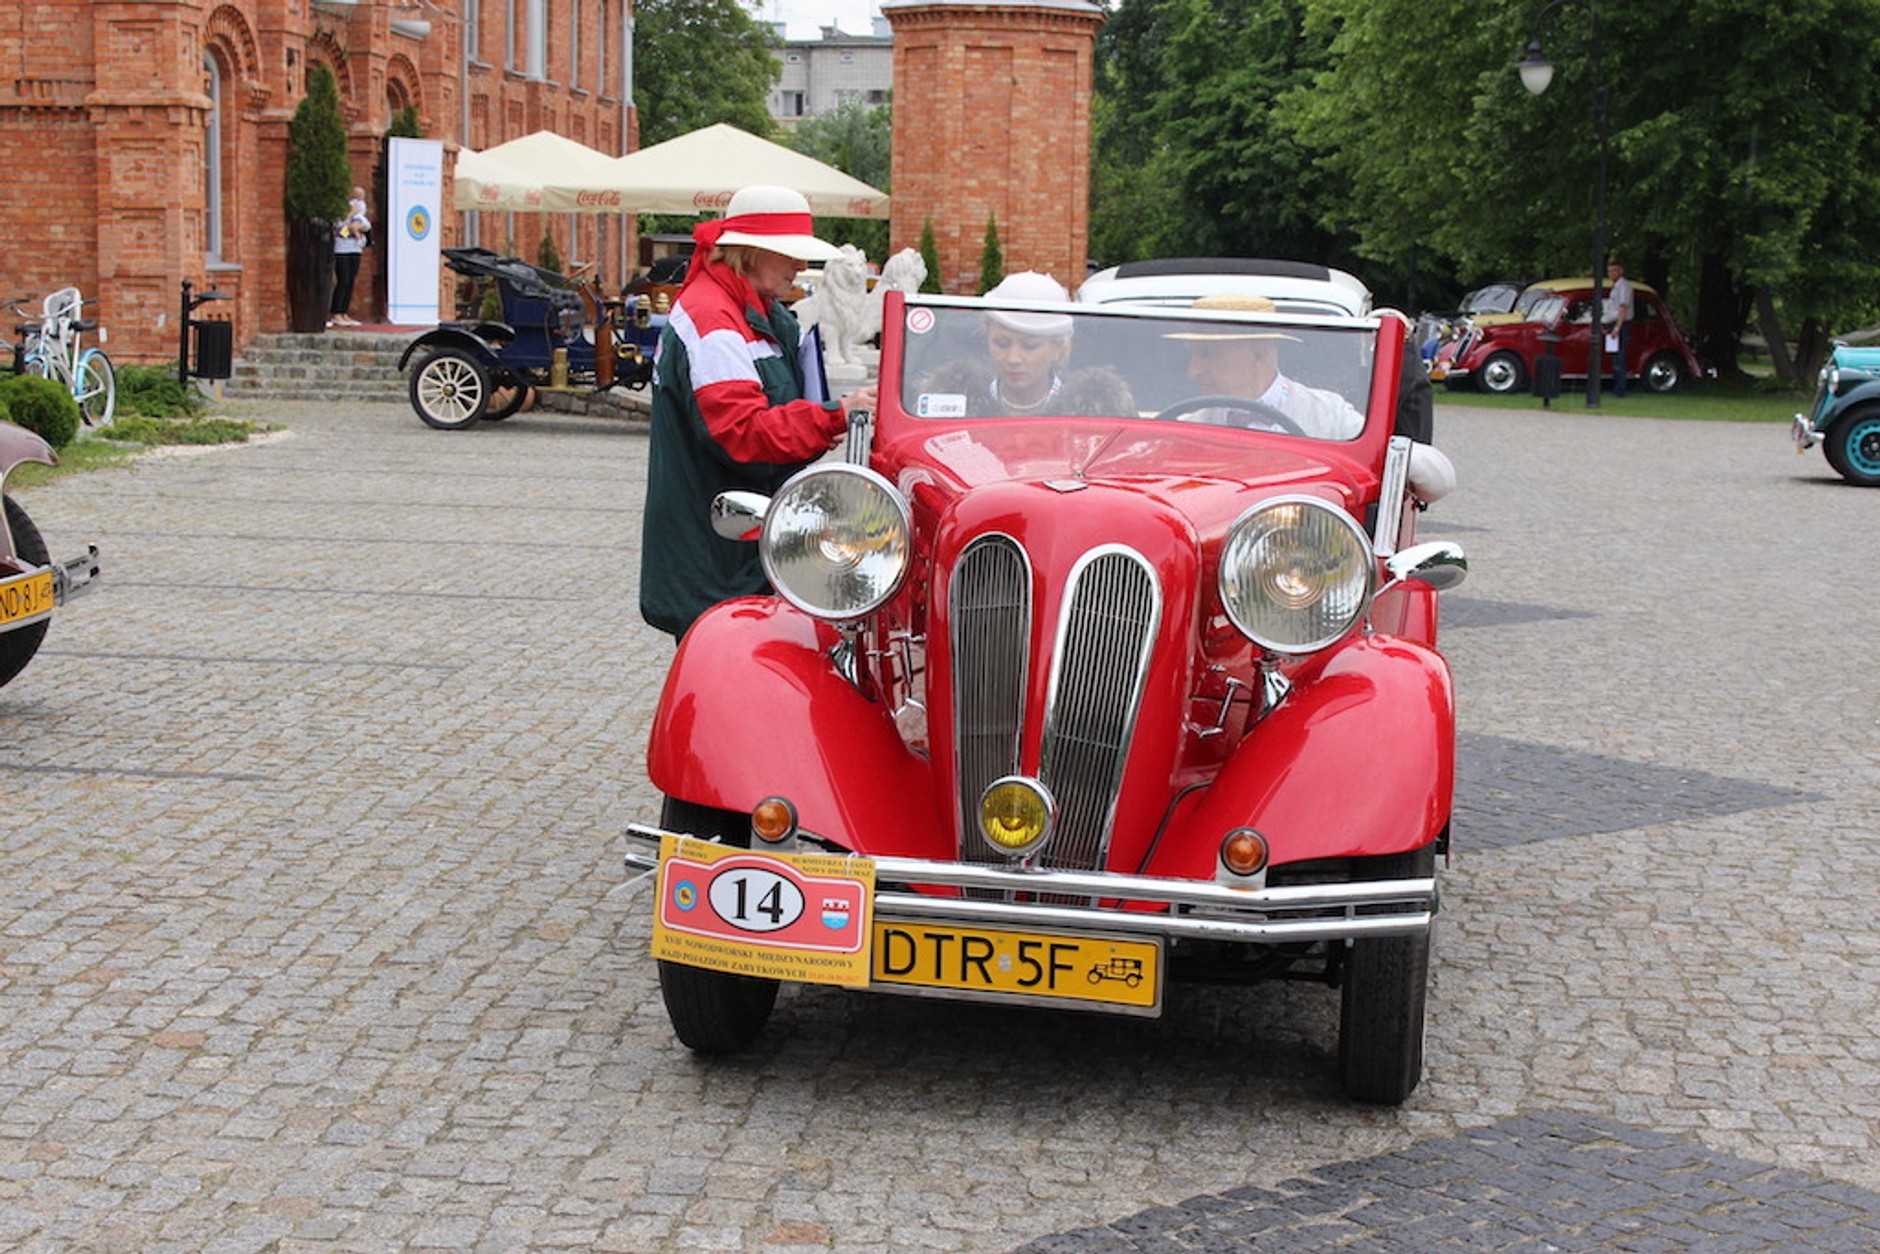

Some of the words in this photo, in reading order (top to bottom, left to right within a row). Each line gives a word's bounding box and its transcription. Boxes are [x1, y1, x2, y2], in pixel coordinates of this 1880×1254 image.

[731, 877, 784, 924] 14
[883, 928, 994, 984] DTR
[1016, 940, 1081, 990] 5F
